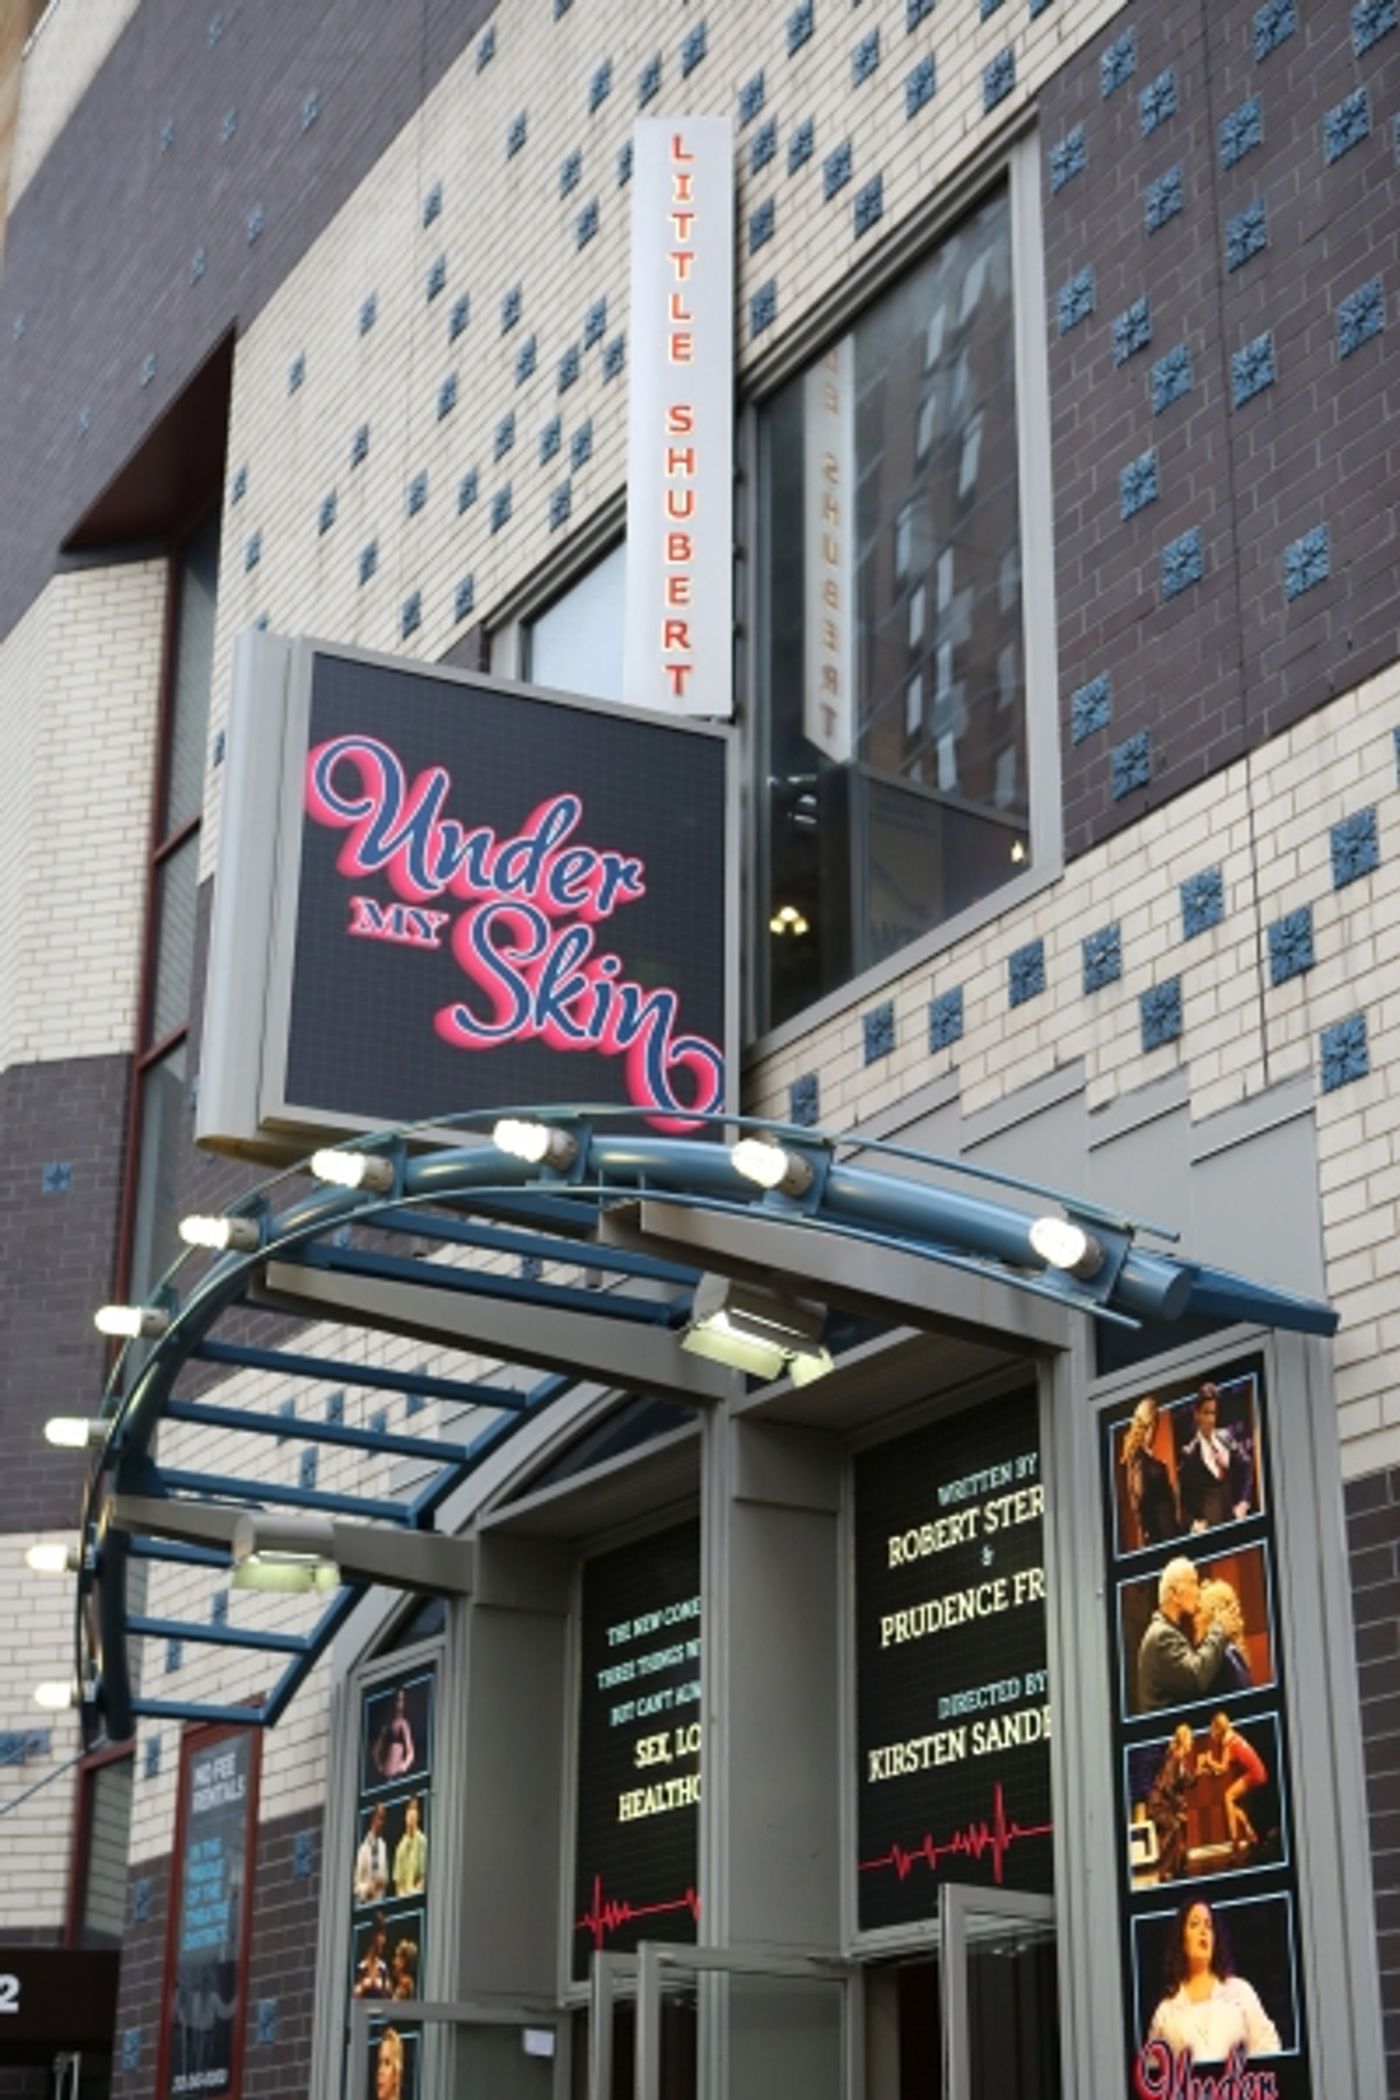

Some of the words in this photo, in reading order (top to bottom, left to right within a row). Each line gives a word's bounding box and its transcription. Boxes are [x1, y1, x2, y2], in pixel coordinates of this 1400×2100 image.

[669, 132, 695, 363] LITTLE
[664, 404, 695, 698] SHUBERT
[304, 735, 646, 921] Under
[348, 896, 449, 949] MY
[434, 899, 726, 1134] Skin
[937, 1460, 1013, 1506] WRITTEN
[1014, 1452, 1038, 1478] BY
[888, 1507, 980, 1568] ROBERT
[983, 1484, 1045, 1534] STER
[881, 1578, 1009, 1648] PRUDENCE
[1012, 1567, 1047, 1606] FR
[938, 1676, 1020, 1720] DIRECTED
[1025, 1669, 1048, 1696] BY
[868, 1726, 967, 1783] KIRSTEN
[0, 1973, 21, 2013] 2
